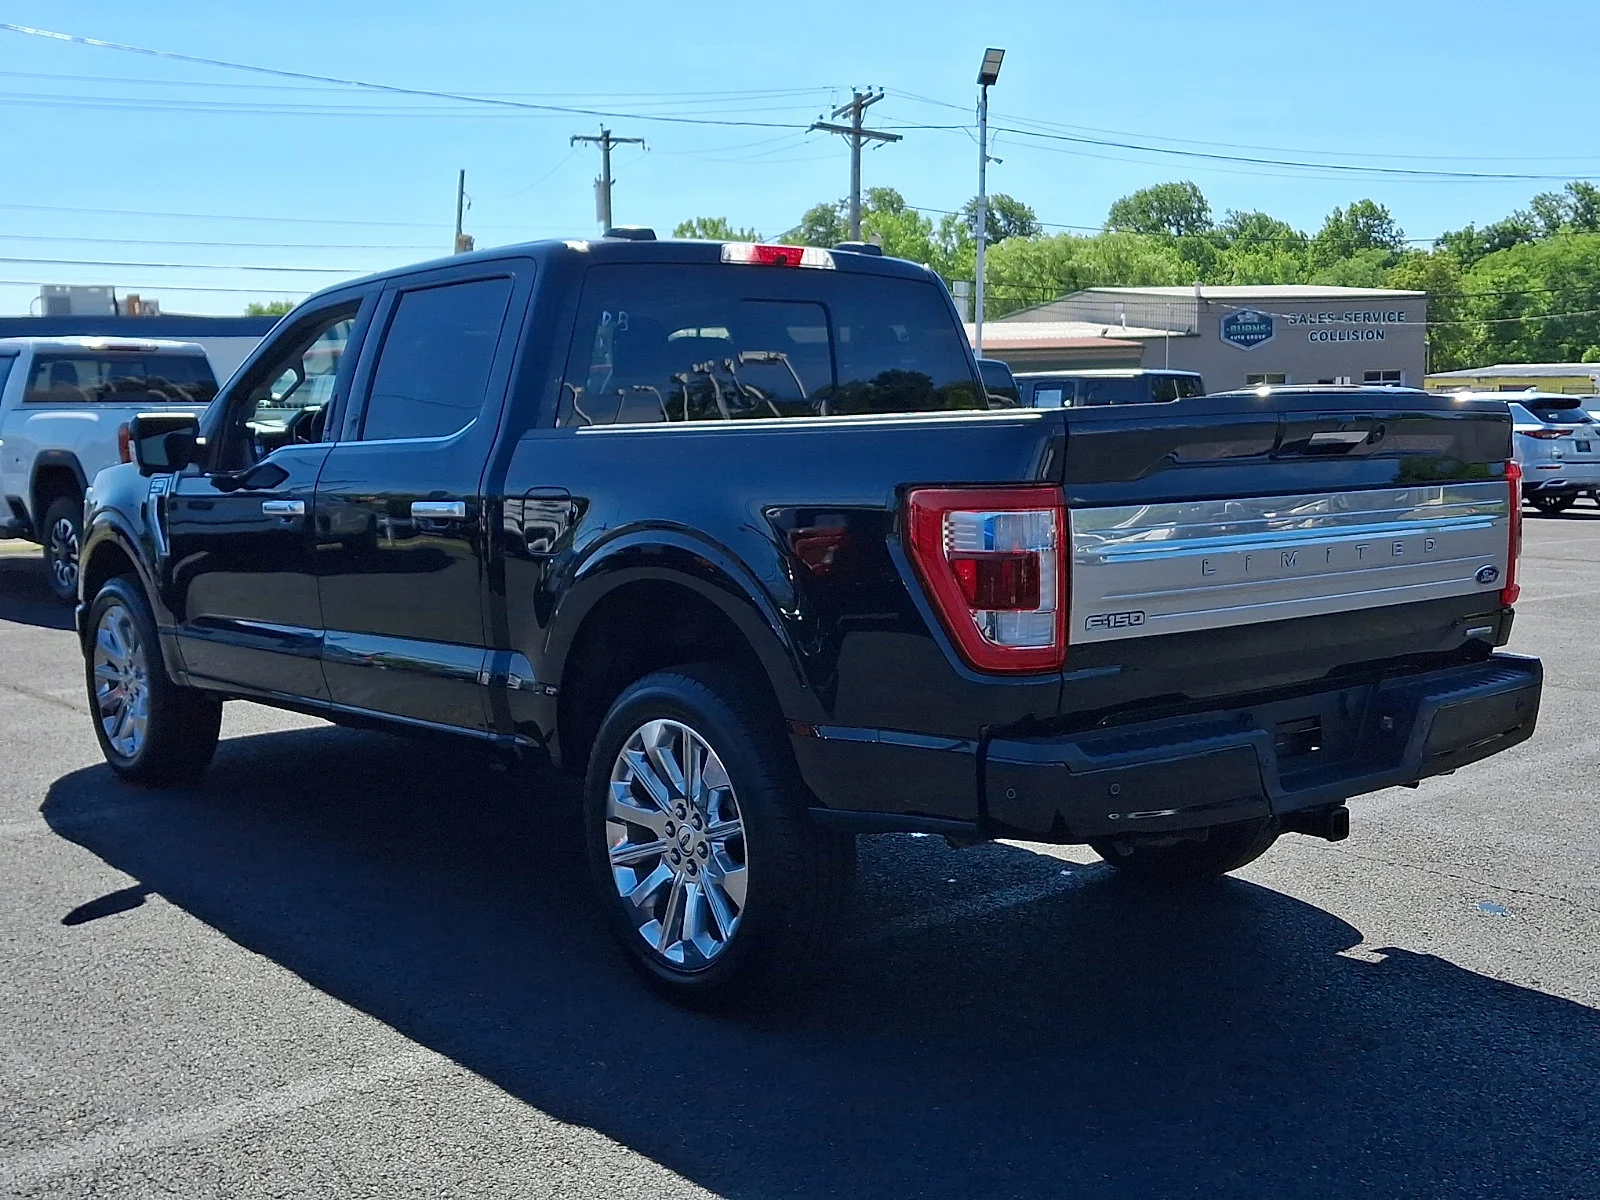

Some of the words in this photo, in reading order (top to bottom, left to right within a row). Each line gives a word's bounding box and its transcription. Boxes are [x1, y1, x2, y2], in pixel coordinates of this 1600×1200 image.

[1288, 312, 1335, 325] SALES
[1343, 311, 1405, 323] SERVICE
[1308, 329, 1385, 342] COLLISION
[1201, 537, 1437, 577] LIMITED
[1085, 610, 1146, 631] F-150
